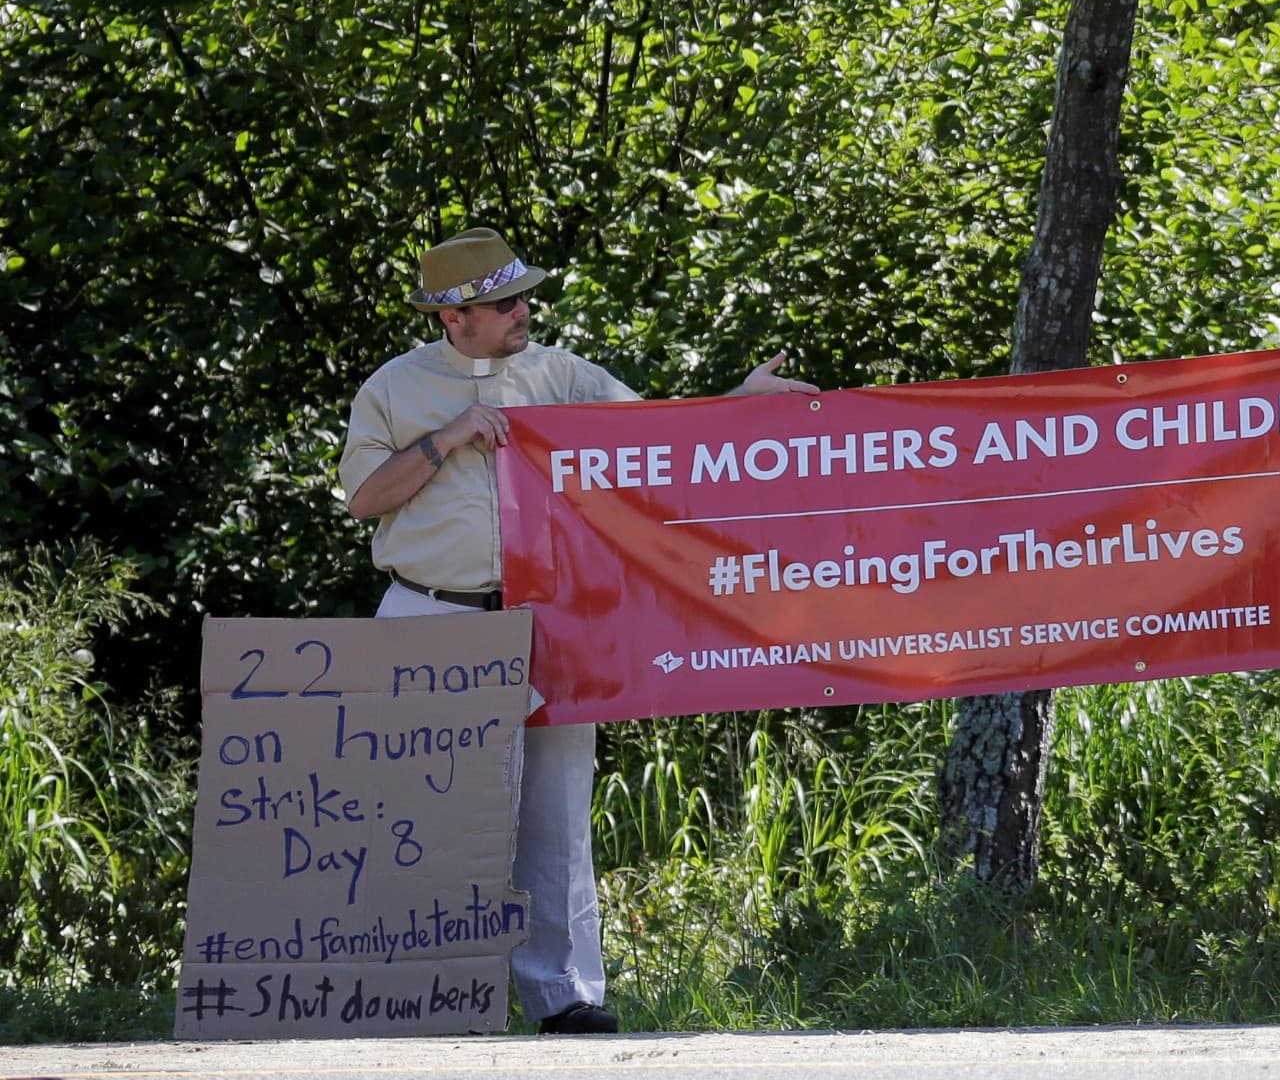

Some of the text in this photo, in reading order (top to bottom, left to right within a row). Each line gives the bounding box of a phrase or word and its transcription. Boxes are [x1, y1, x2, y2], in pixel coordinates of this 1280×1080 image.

[550, 445, 672, 493] FREE
[690, 425, 957, 483] MOTHERS
[973, 415, 1098, 465] AND
[708, 519, 1244, 596] #FleeingForTheirLives
[230, 640, 525, 699] 22 moms
[690, 605, 1271, 671] UNITARIAN UNIVERSALIST SERVICE COMMITTEE
[219, 730, 281, 765] on
[335, 705, 499, 793] hunger
[283, 819, 423, 904] Day 8
